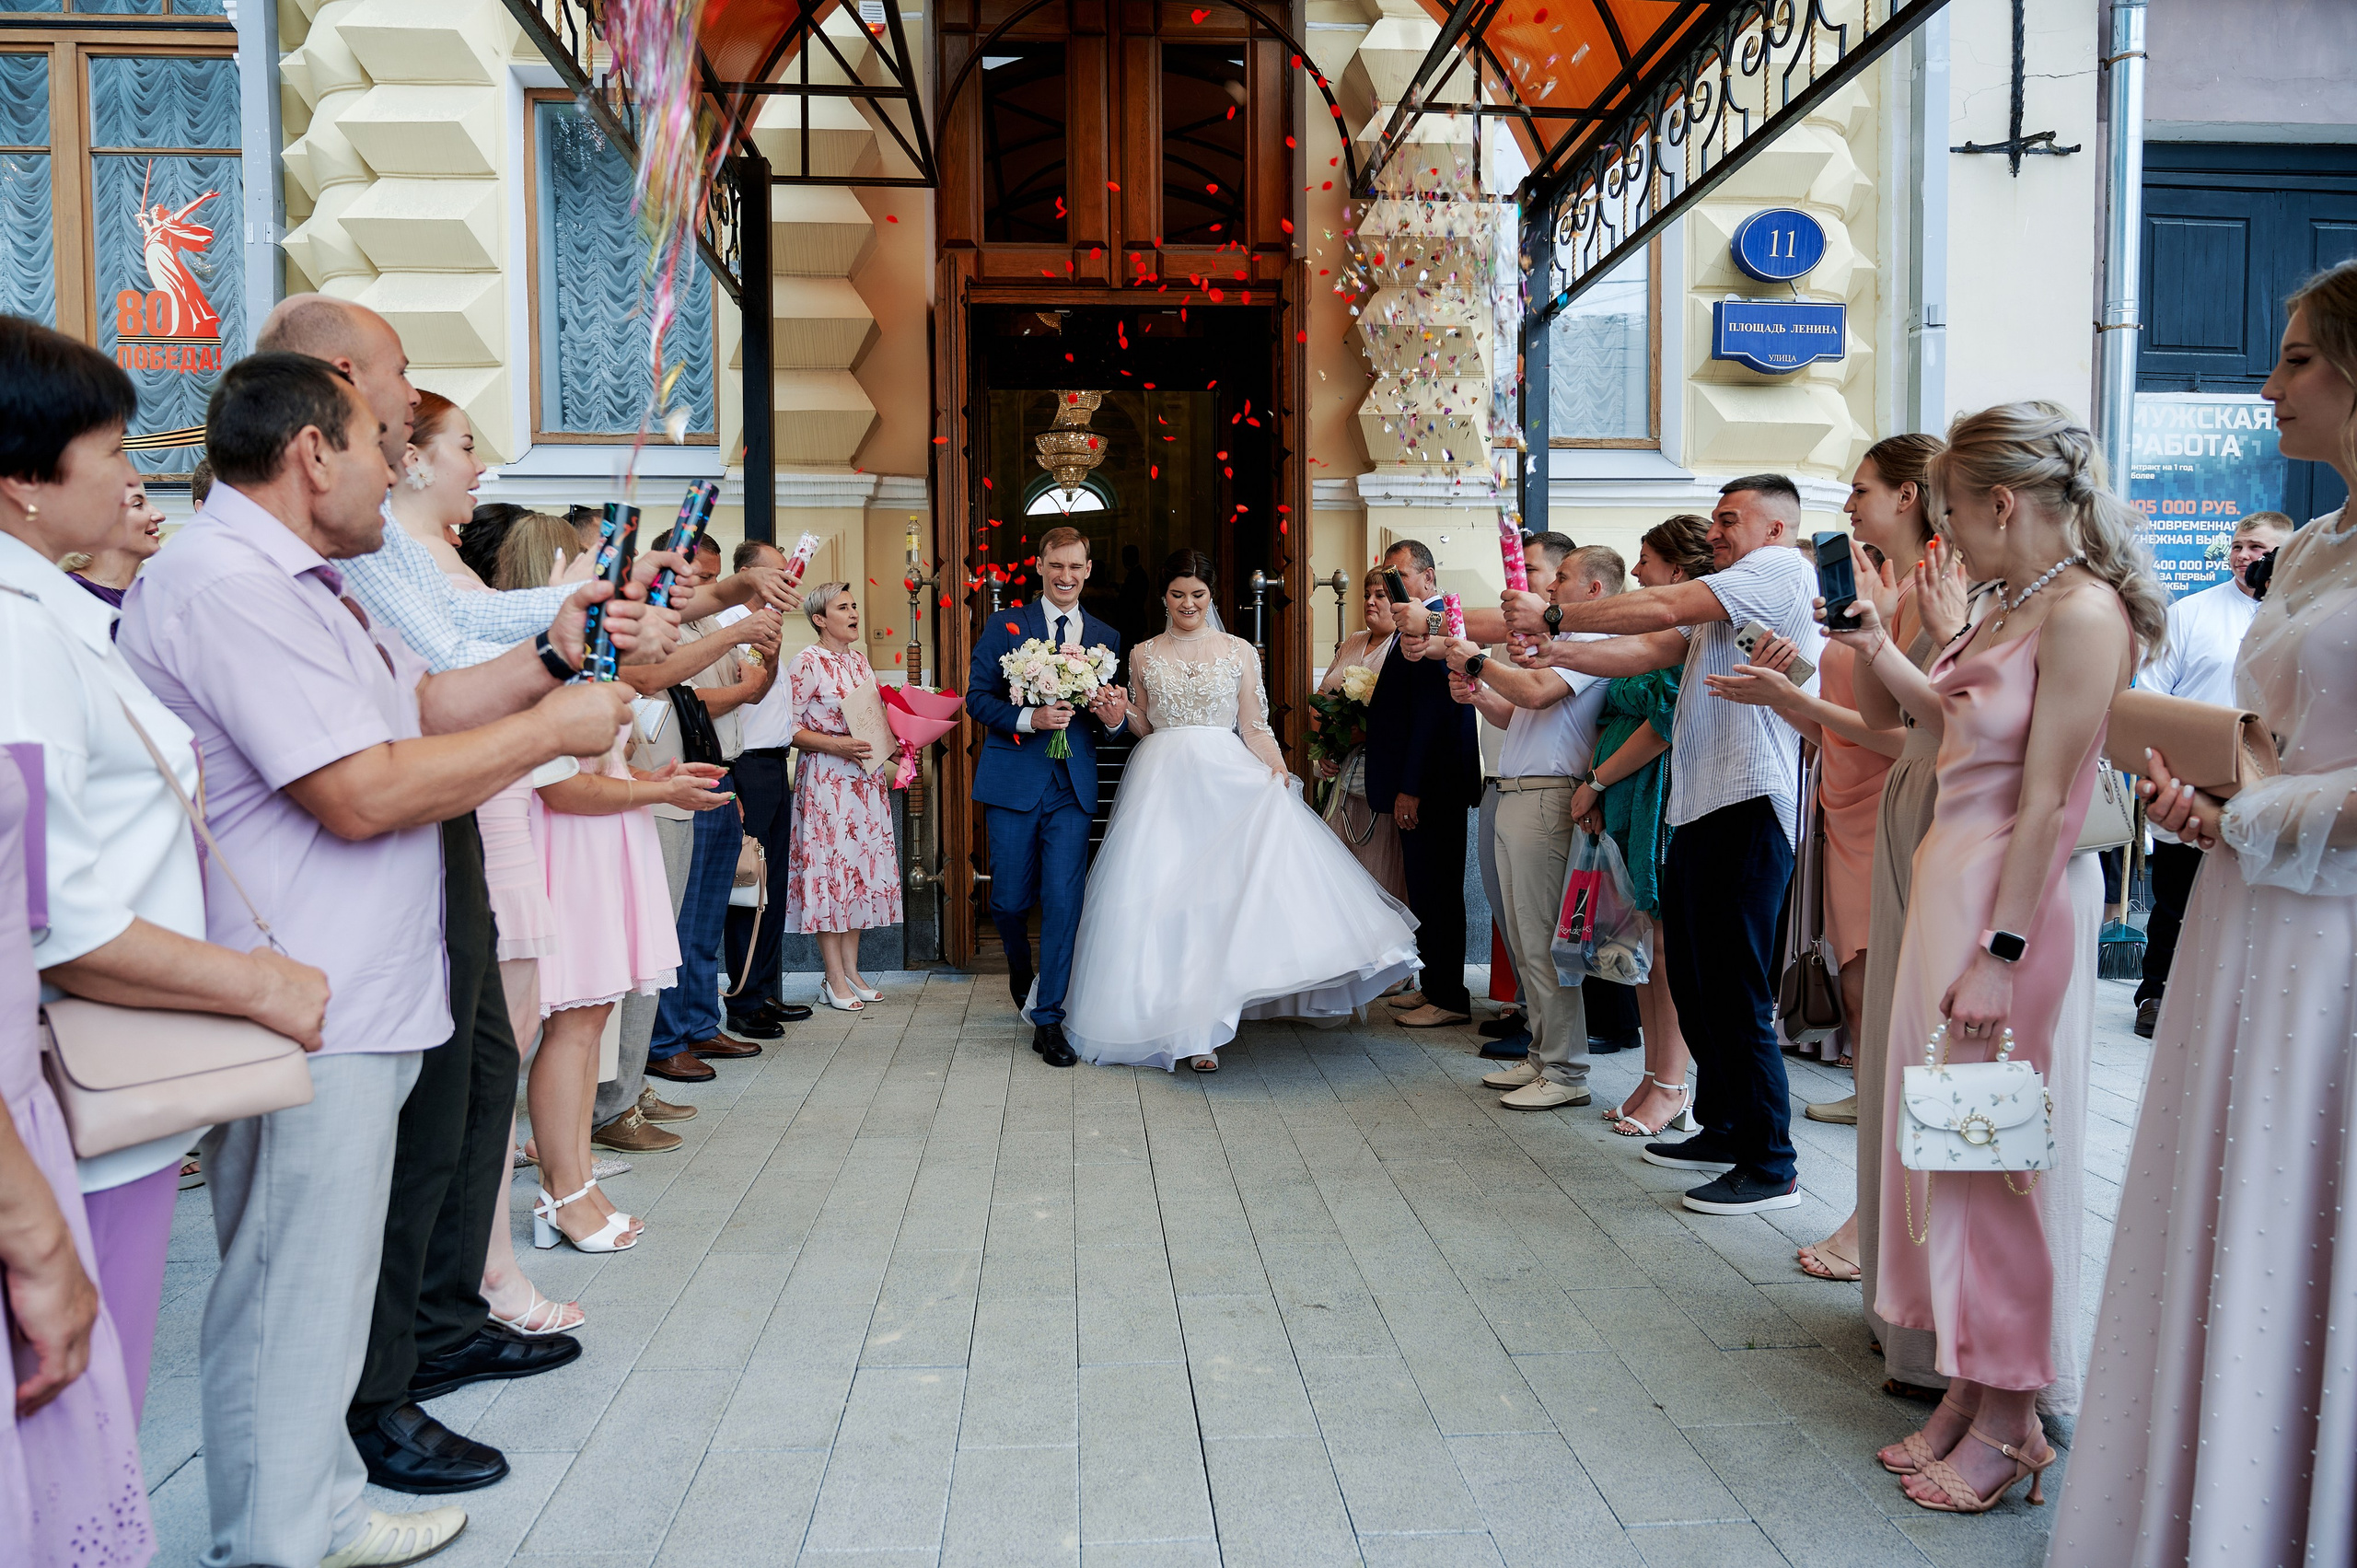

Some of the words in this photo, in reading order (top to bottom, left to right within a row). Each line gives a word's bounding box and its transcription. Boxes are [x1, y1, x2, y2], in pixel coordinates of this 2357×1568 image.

[1769, 229, 1795, 258] 11
[116, 289, 172, 336] 80
[1728, 322, 1786, 334] ПЛОЩАДЬ
[1791, 324, 1838, 334] ЛЕНИНА
[117, 345, 222, 375] ПОБЕДА!
[1768, 354, 1797, 363] УЛИЦА
[2179, 464, 2194, 472] год
[2162, 500, 2197, 515] 000
[2201, 500, 2241, 516] РУБ.
[2153, 560, 2177, 571] 400
[2179, 560, 2202, 571] 000
[2159, 572, 2173, 581] ЗА
[2175, 570, 2216, 581] ПЕРВЫЙ
